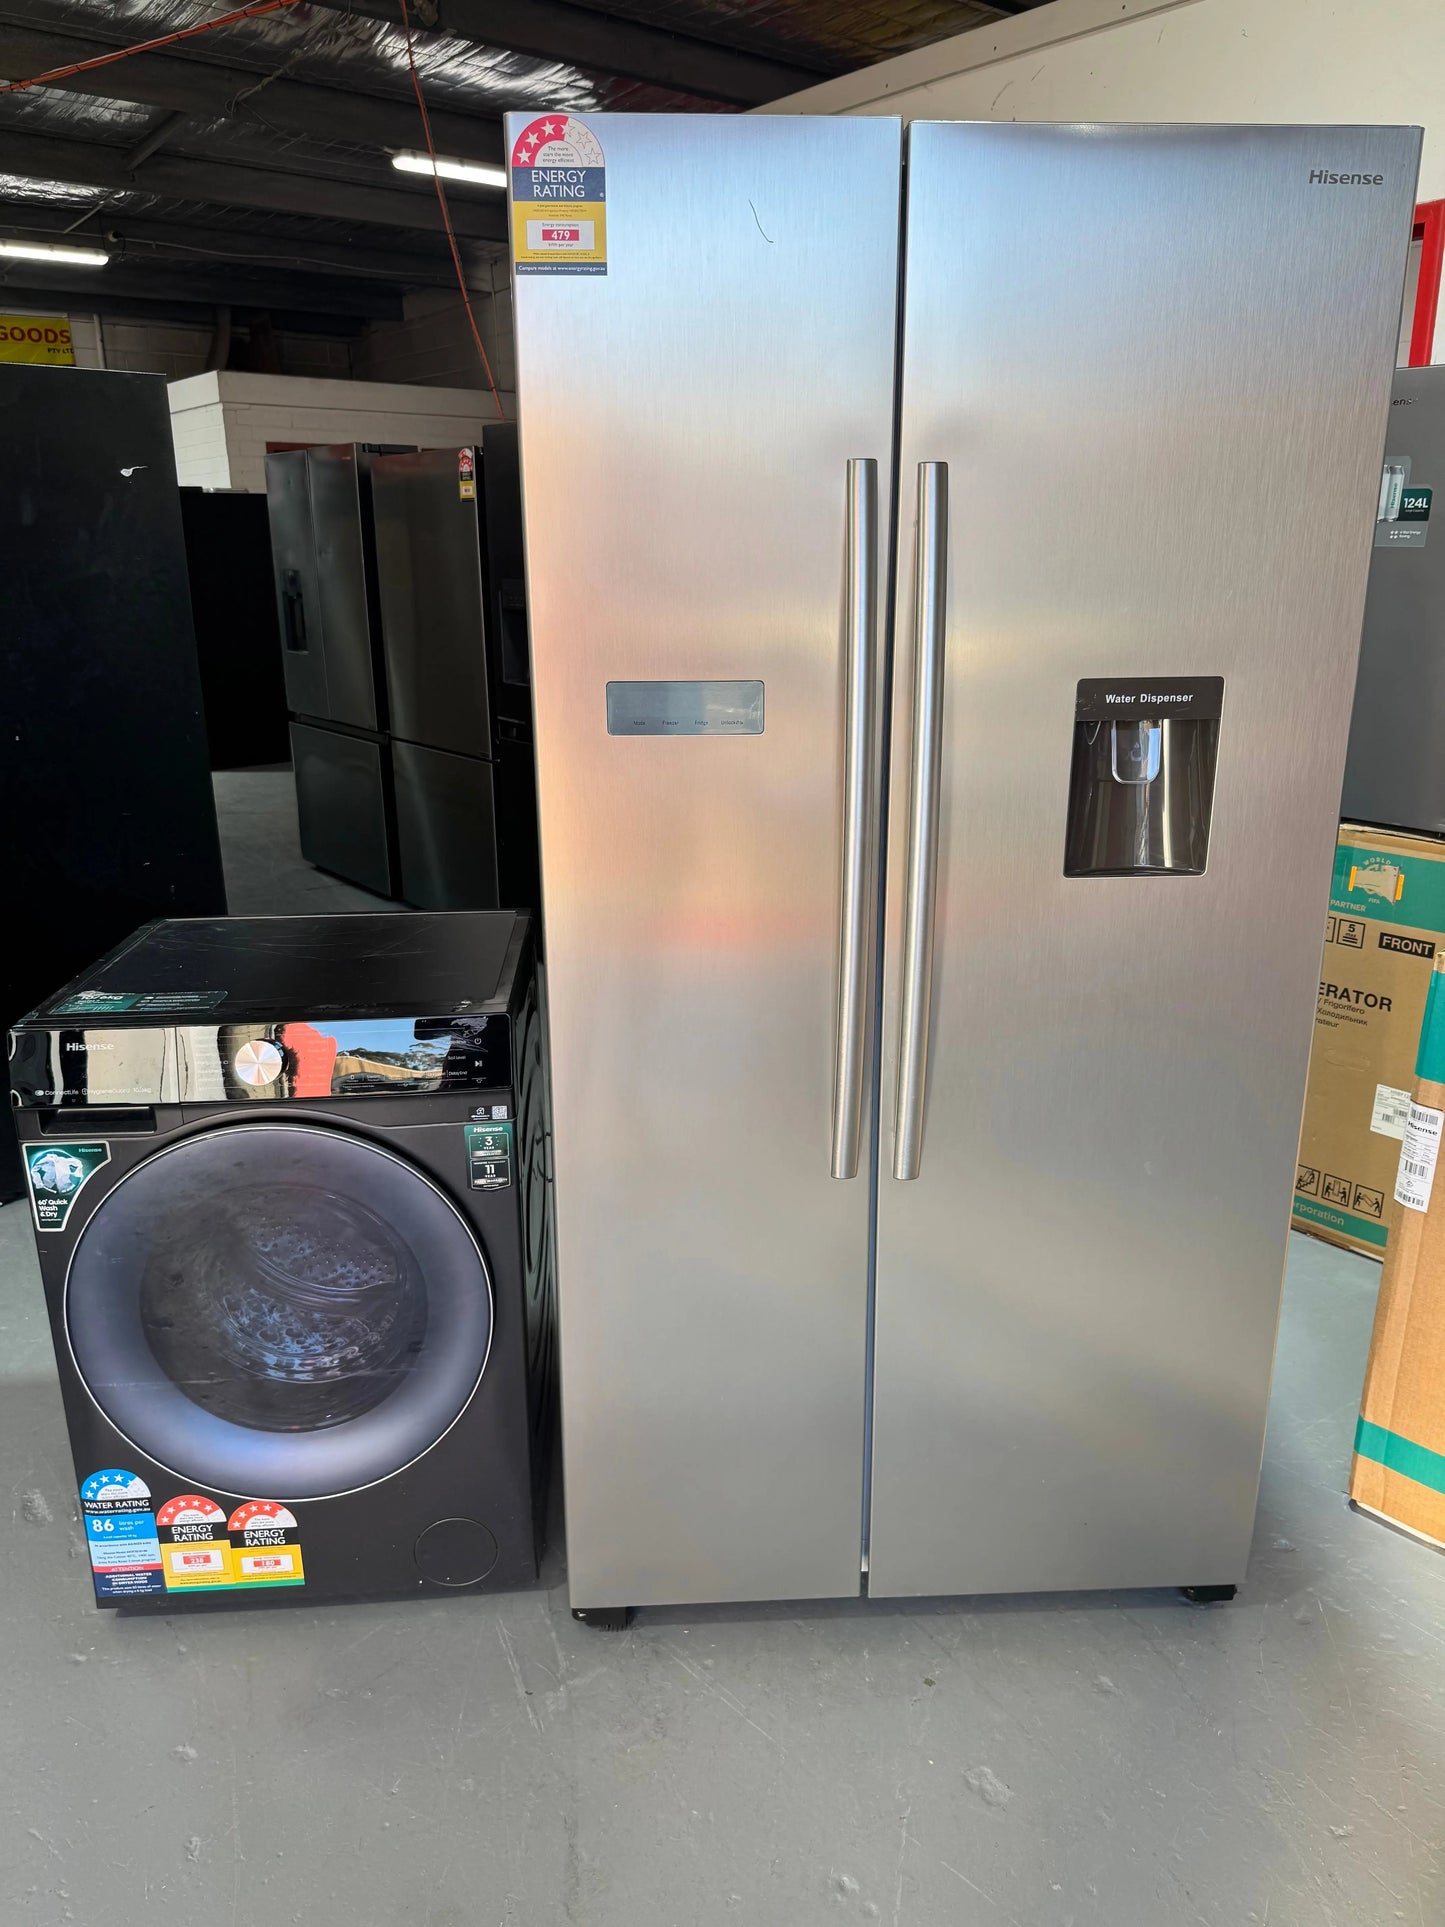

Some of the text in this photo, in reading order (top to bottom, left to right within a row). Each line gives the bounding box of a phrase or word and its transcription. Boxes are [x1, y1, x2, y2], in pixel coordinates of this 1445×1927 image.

[531, 170, 586, 183] ENERGY
[1308, 169, 1384, 186] Hisense
[533, 185, 585, 198] RATING
[551, 230, 570, 240] 479
[1404, 498, 1428, 508] 124L
[1105, 693, 1194, 704] Water Dispenser
[1363, 857, 1392, 866] WORLD
[1330, 900, 1367, 912] PARTNER
[1348, 924, 1356, 933] 5
[1382, 935, 1433, 956] FRONT
[66, 1042, 115, 1051] Hisense
[1408, 1120, 1438, 1135] Hisense
[485, 1136, 493, 1146] 3
[484, 1165, 495, 1174] 11
[115, 1500, 150, 1508] RATING
[92, 1518, 115, 1532] 86
[172, 1524, 213, 1534] ENERGY
[174, 1532, 214, 1542] RATING
[244, 1529, 285, 1538] ENERGY
[246, 1537, 286, 1546] RATING
